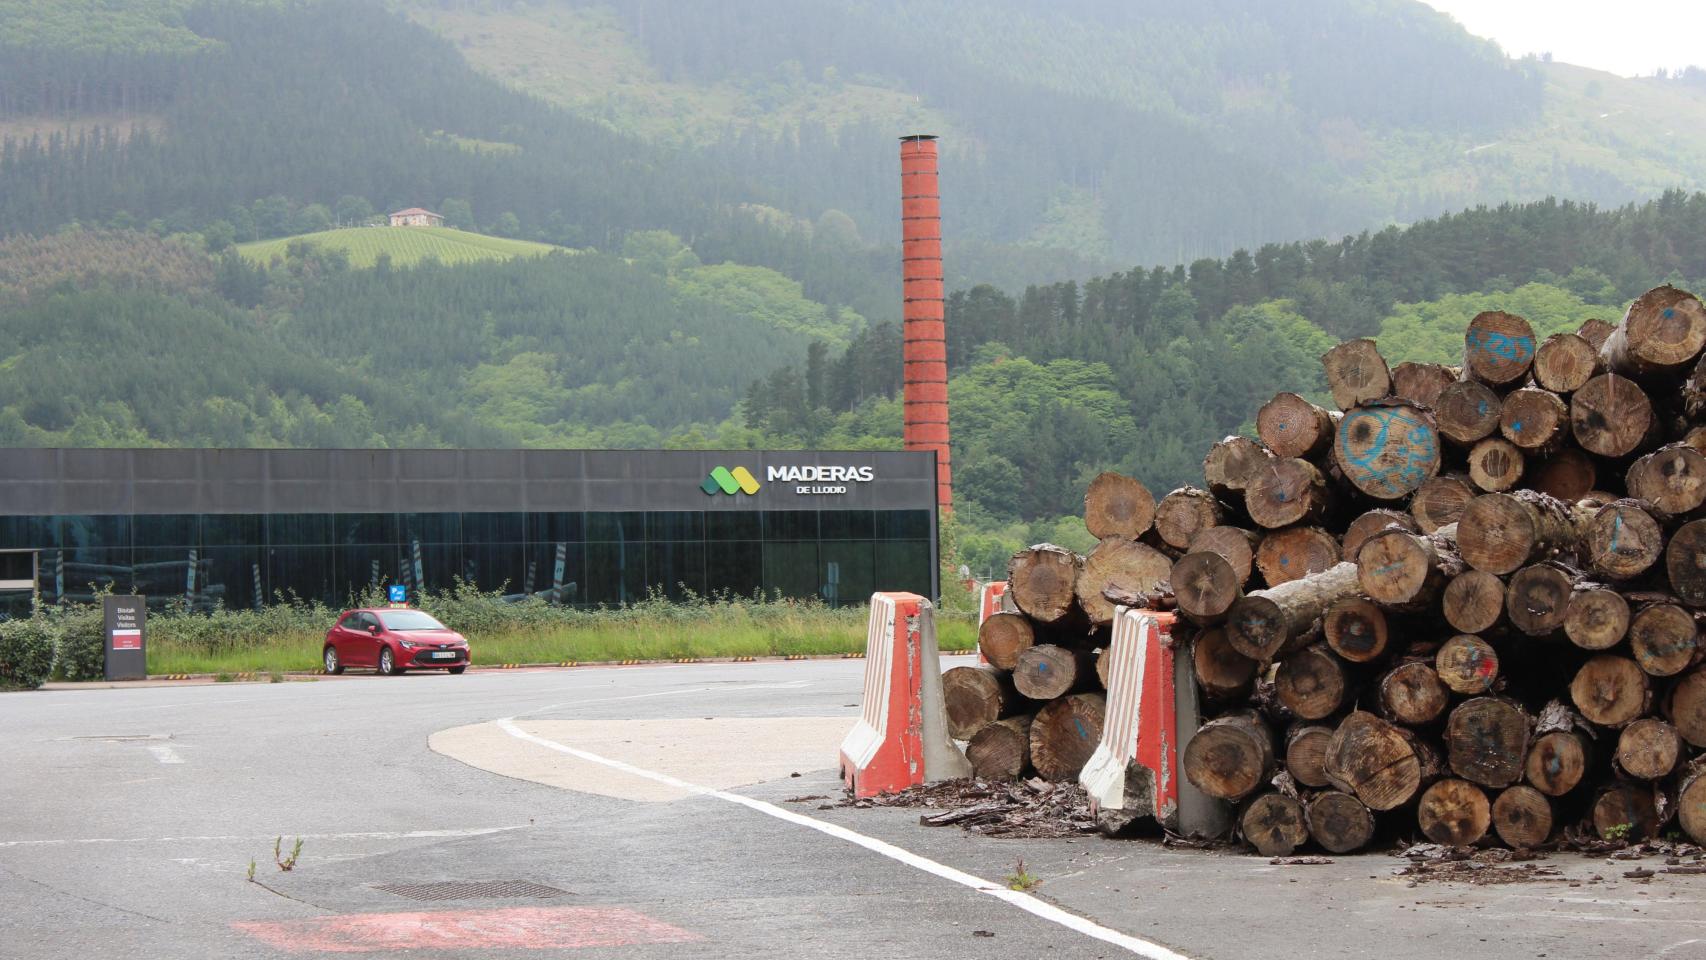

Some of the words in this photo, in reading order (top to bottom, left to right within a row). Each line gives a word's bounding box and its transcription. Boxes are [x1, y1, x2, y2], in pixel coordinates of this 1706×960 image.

[767, 466, 874, 482] MADERAS
[796, 486, 811, 494] DE
[812, 486, 847, 494] LLODIO
